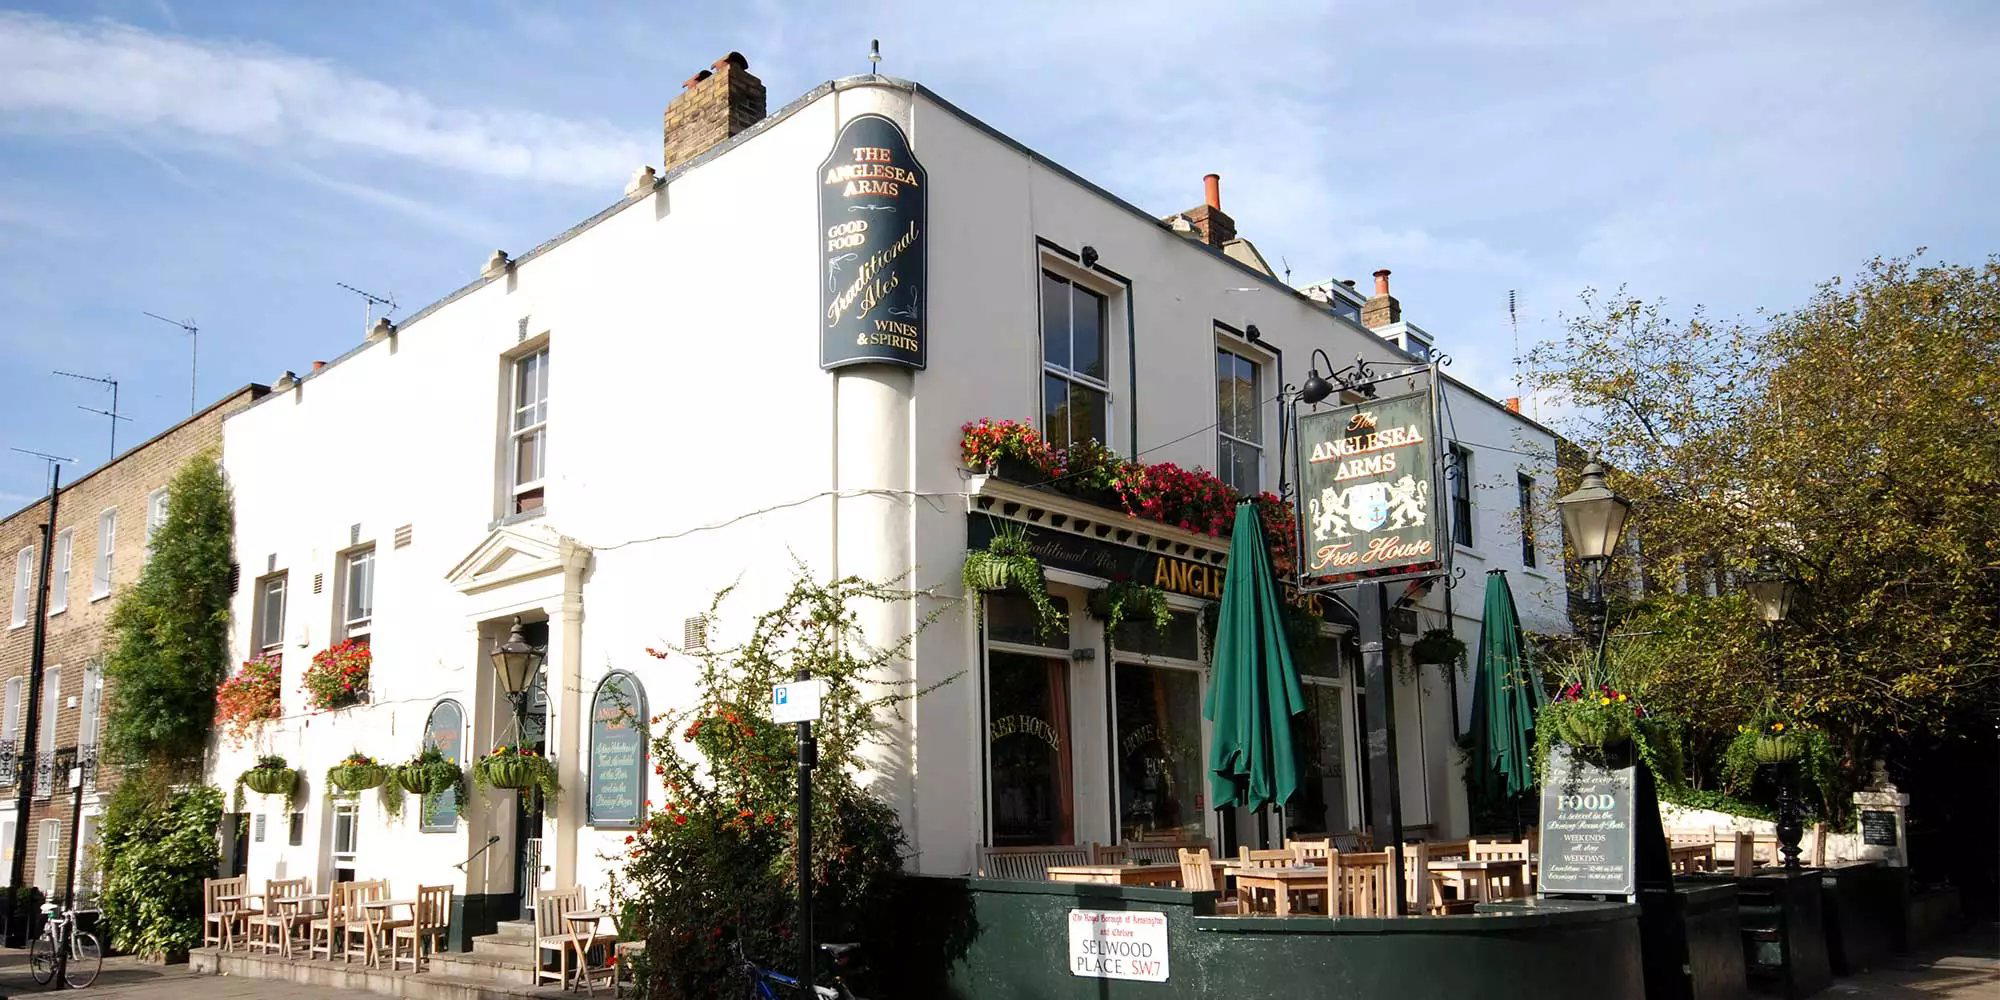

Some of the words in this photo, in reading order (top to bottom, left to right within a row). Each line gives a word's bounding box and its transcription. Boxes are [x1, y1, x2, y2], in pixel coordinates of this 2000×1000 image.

[853, 147, 891, 161] THE
[825, 163, 919, 187] ANGLESEA
[843, 180, 899, 197] ARMS
[828, 219, 868, 238] GOOD
[828, 233, 866, 252] FOOD
[827, 219, 920, 328] Traditional
[856, 271, 899, 320] Ales
[874, 319, 918, 337] WINES
[856, 332, 868, 345] &
[870, 333, 919, 352] SPIRITS
[1347, 411, 1378, 432] The
[1309, 424, 1424, 464] ANGLESEA
[1334, 452, 1396, 482] ARMS
[1310, 541, 1359, 570] Free
[1361, 535, 1433, 564] House
[1153, 556, 1223, 598] ANGLE
[990, 715, 1016, 743] REE
[1557, 794, 1615, 811] FOOD
[1563, 834, 1606, 842] WEEKENDS
[1101, 912, 1122, 925] Borough
[1133, 914, 1163, 927] Kensington
[1082, 939, 1153, 958] SELWOOD
